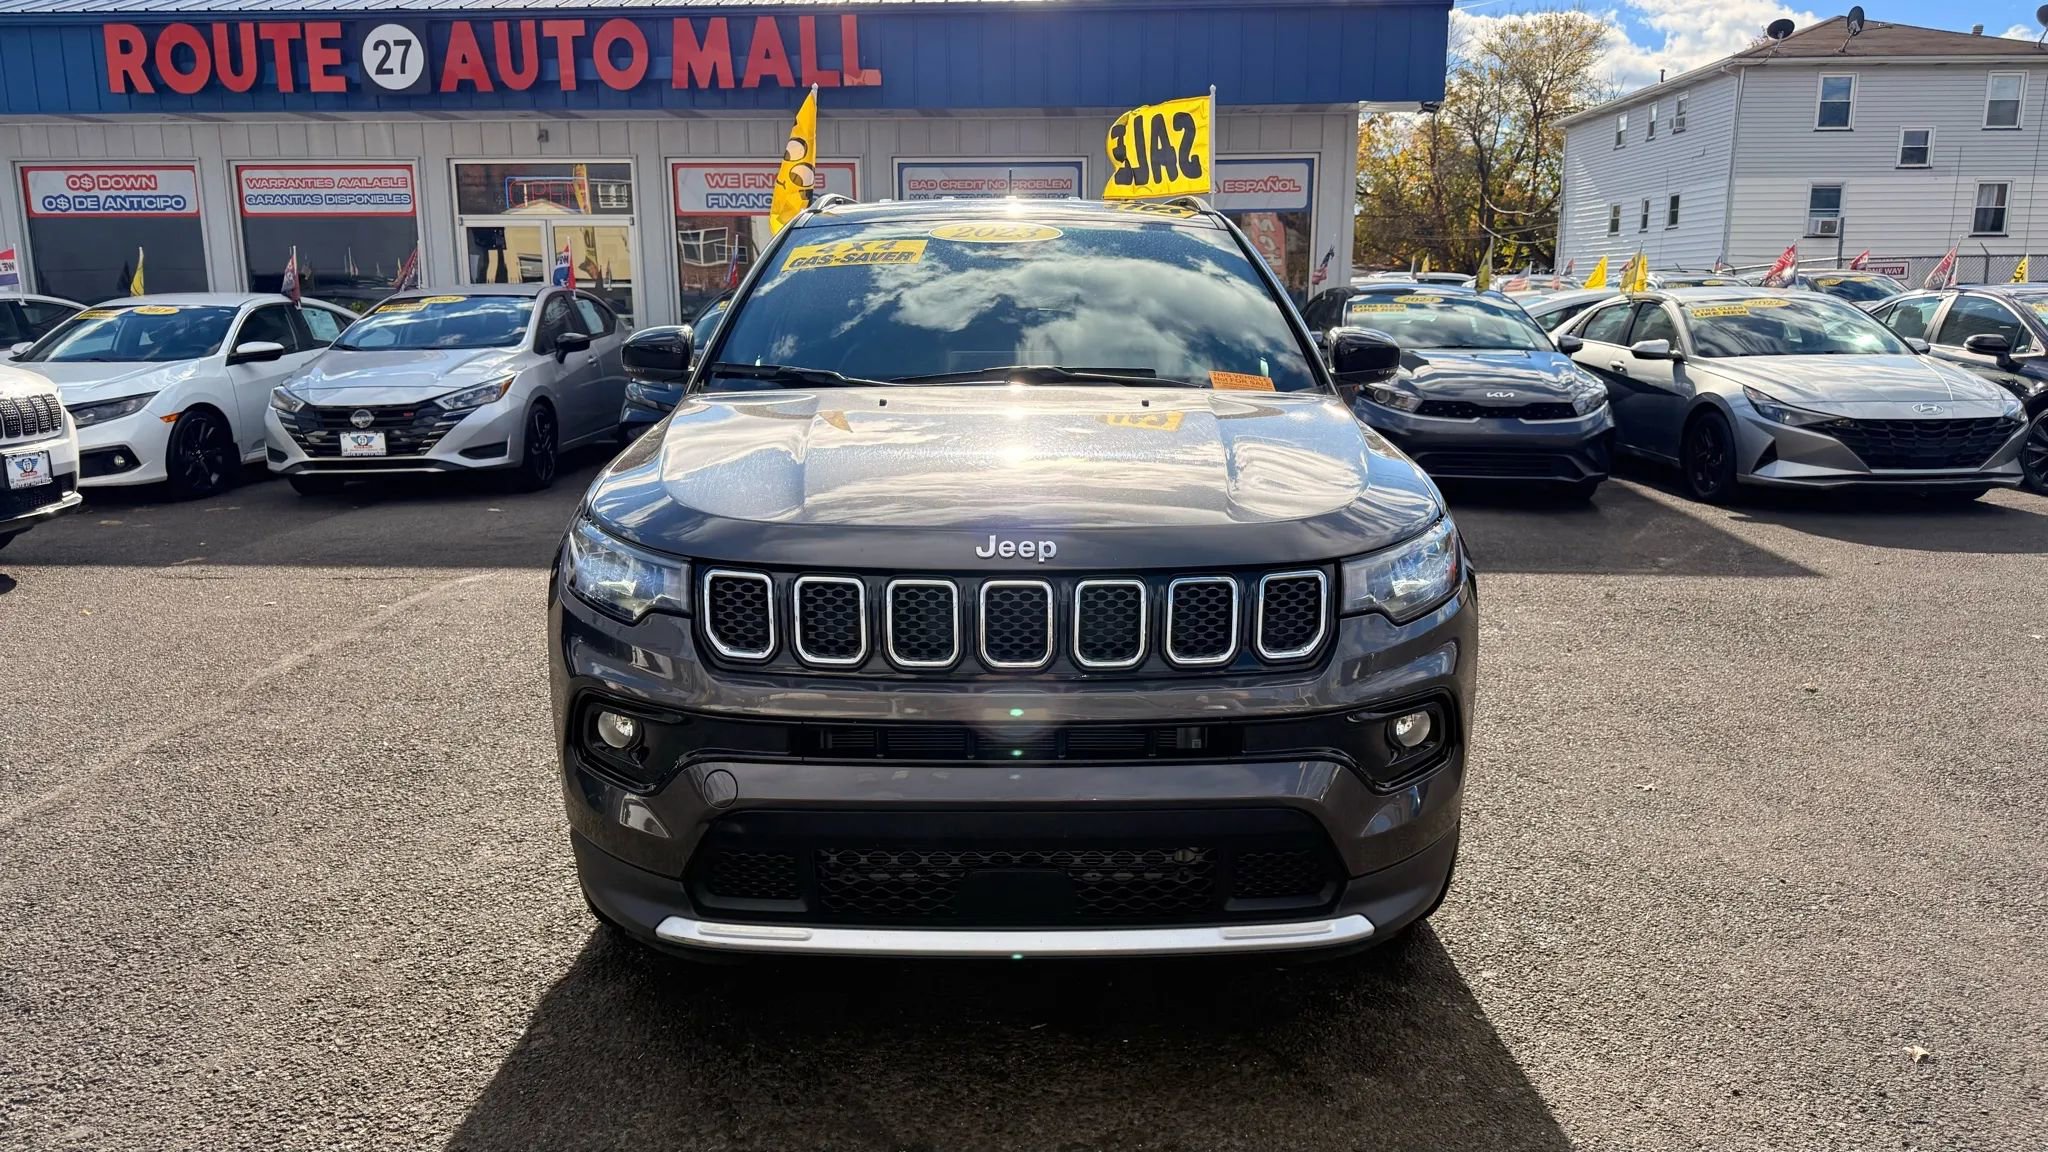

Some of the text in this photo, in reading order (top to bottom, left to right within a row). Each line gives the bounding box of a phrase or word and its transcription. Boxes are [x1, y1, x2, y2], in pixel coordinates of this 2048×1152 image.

[103, 14, 881, 95] ROUTE 27 AUTO MALL
[98, 174, 157, 190] DOWN
[246, 176, 407, 190] WARRANTIES AVAILABLE
[705, 172, 741, 188] WE
[909, 179, 1072, 191] BAD CREDIT NO PROBLEM
[1223, 176, 1302, 193] ESPAÑOL
[74, 195, 100, 211] DE
[103, 195, 186, 211] ANTICIPO
[246, 193, 411, 206] GARANTIAS DISPONIBLES
[950, 225, 1043, 239] 2023
[788, 251, 917, 269] GAS-SAVER
[1885, 267, 1903, 275] WAY
[975, 534, 1057, 562] Jeep
